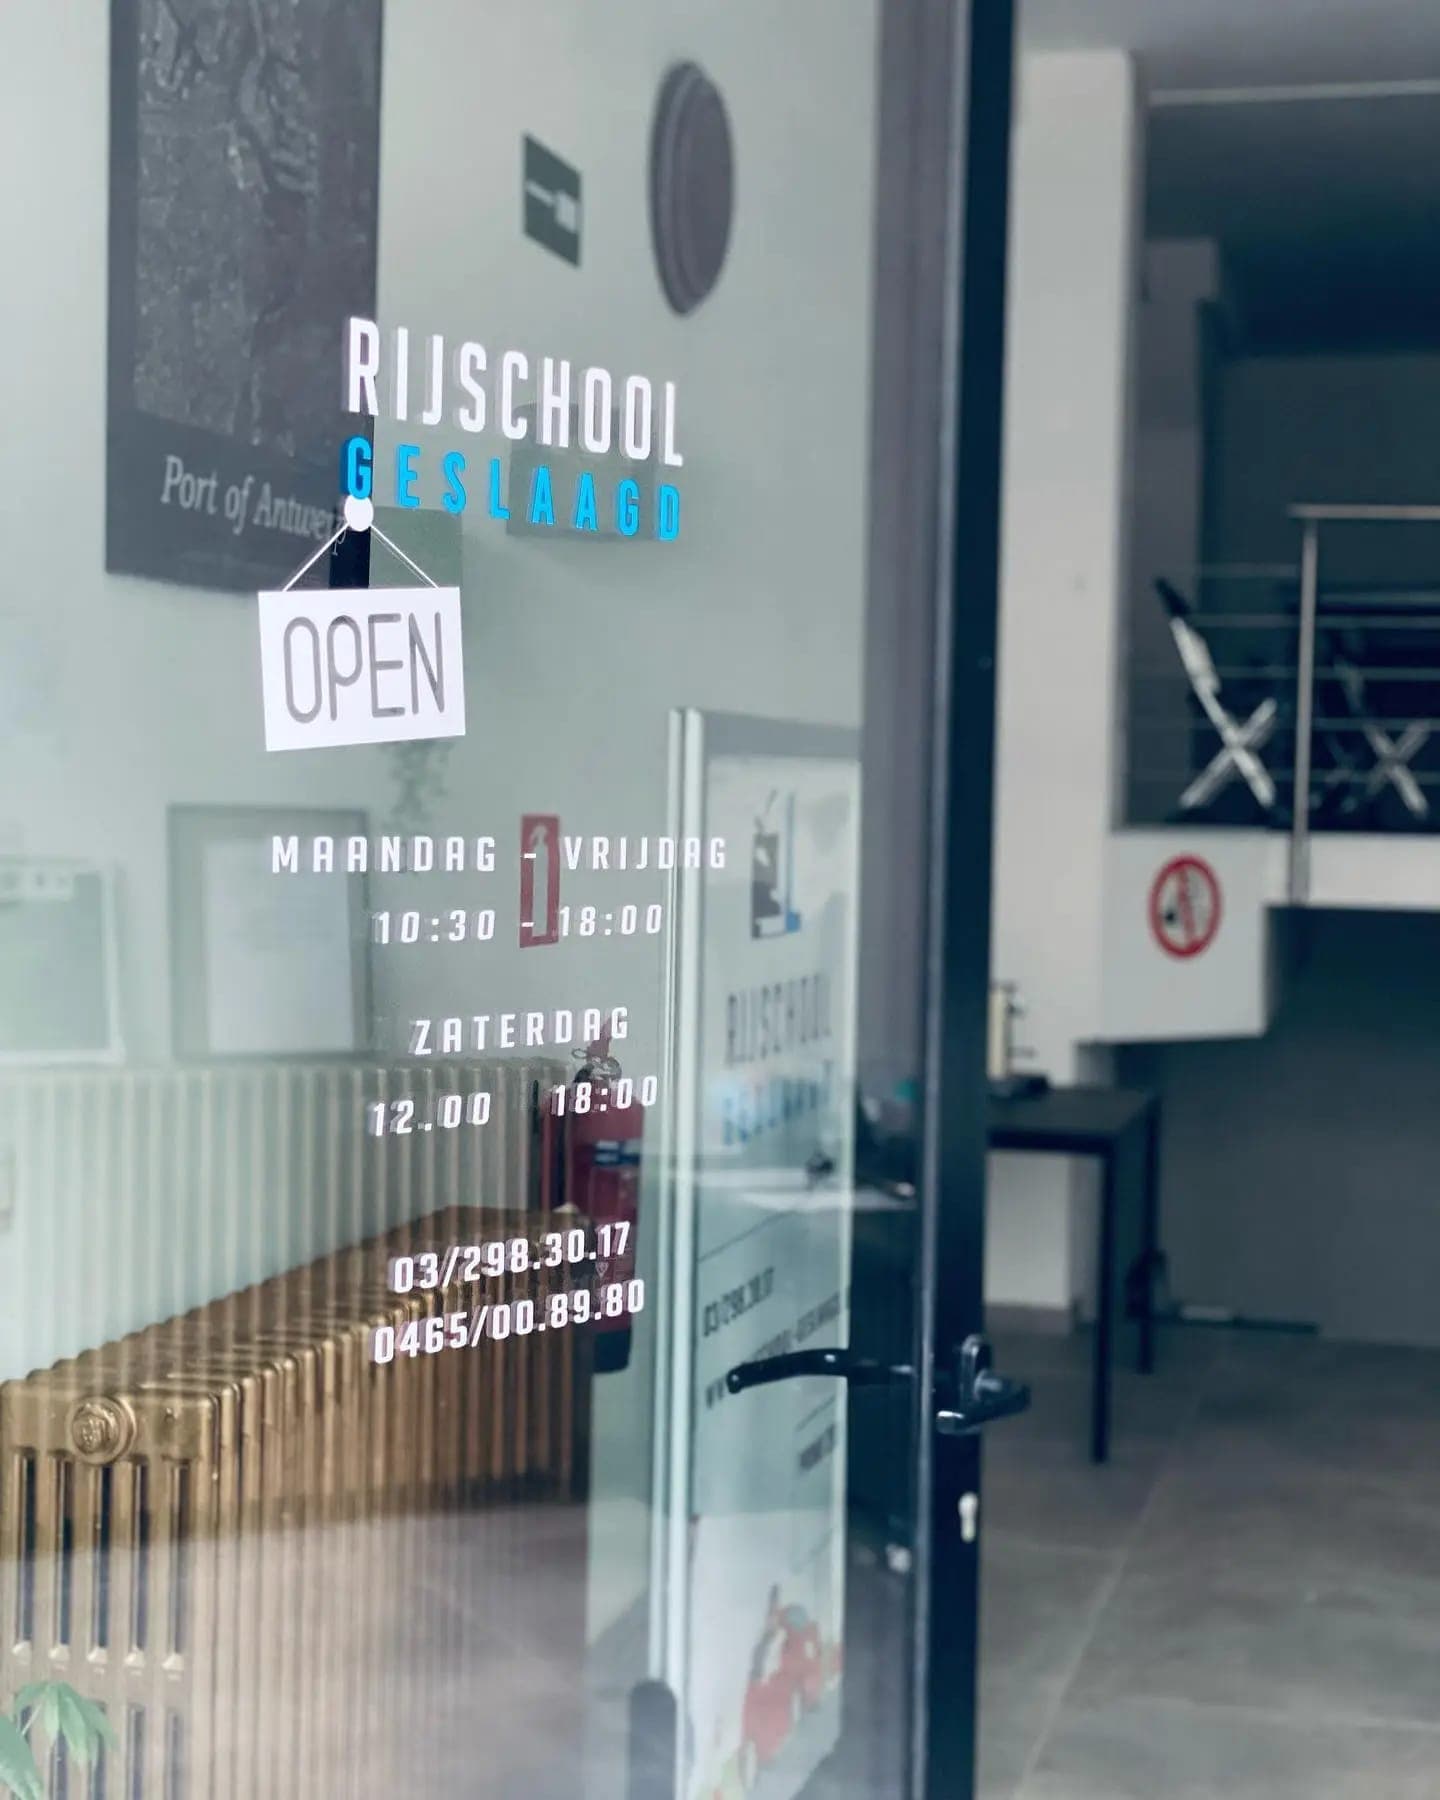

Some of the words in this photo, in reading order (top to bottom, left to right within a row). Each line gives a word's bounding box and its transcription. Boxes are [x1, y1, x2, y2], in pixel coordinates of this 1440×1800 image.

[349, 316, 683, 467] RIJSCHOOL
[160, 453, 219, 515] Port
[224, 474, 255, 536] of
[346, 436, 680, 542] GESLAAGD
[282, 611, 446, 724] OPEN
[271, 836, 496, 874] MAANDAG
[564, 836, 727, 871] VRIJDAG
[376, 910, 496, 945] 10:30
[559, 904, 664, 938] 18:00
[414, 1007, 630, 1056] ZATERDAG
[373, 1092, 492, 1137] 12.00
[554, 1075, 658, 1117] 18:00
[393, 1221, 631, 1294] 03/298.30.17
[374, 1279, 645, 1364] 0465/00.89.80
